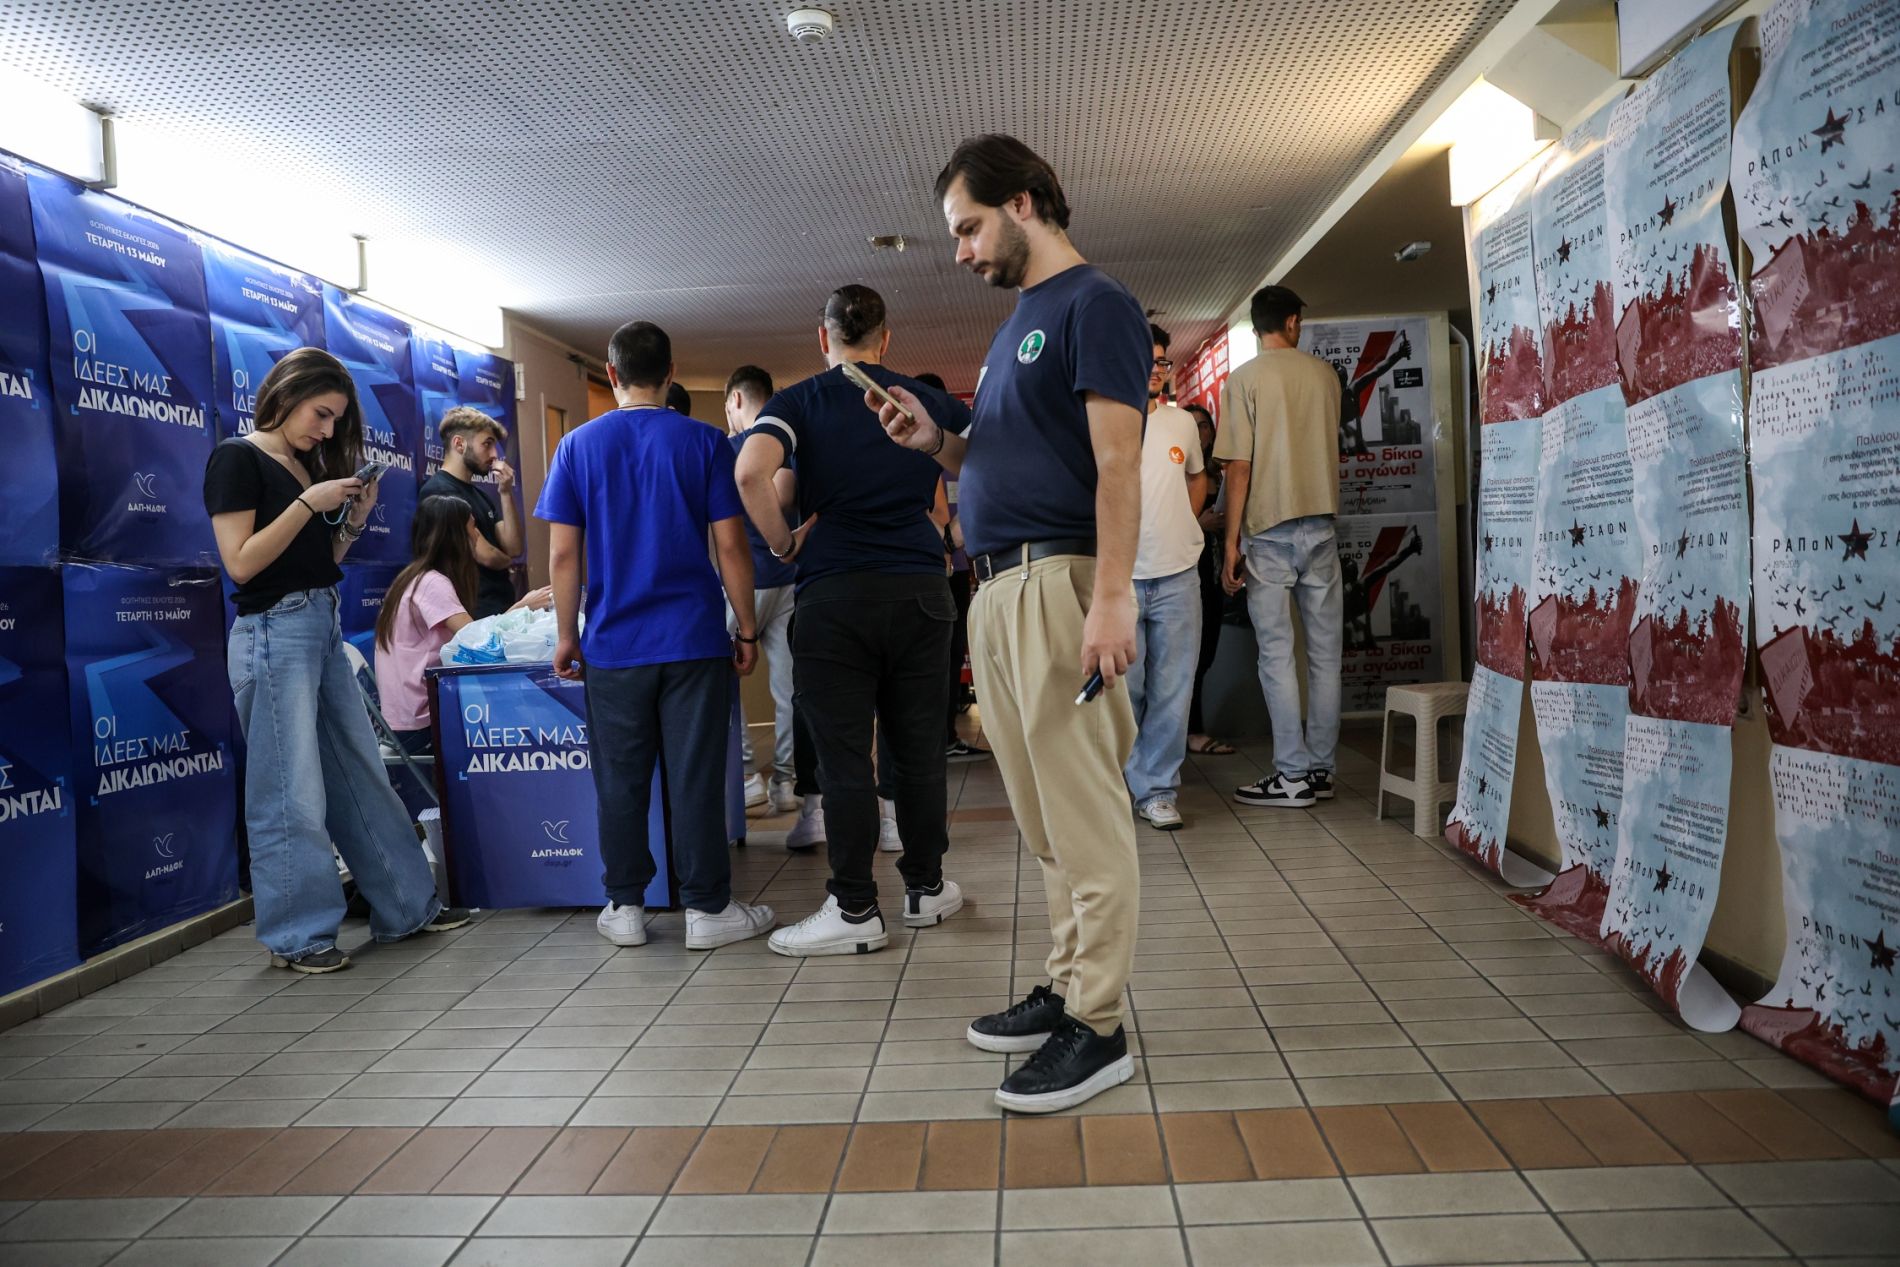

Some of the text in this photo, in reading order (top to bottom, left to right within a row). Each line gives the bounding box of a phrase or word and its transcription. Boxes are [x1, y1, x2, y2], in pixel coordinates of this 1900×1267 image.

[85, 232, 166, 268] ΤΕΤΑΡΤΗ 13 ΜΑΪΟΥ
[241, 287, 298, 314] ΤΕΤΑΡΤΗ 13 ΜΑΪΟΥ
[74, 329, 96, 353] ΟΙ
[1312, 346, 1321, 355] ή
[1326, 347, 1341, 356] με
[74, 356, 172, 397] ΙΔΕΕΣ ΜΑΣ
[233, 368, 249, 390] ΟΙ
[77, 386, 204, 428] ΔΙΚΑΙΩΝΟΝΤΑΙ
[233, 392, 256, 414] ΙΔΕ
[375, 430, 396, 448] ΜΑΣ
[425, 426, 433, 440] ΟΙ
[1357, 452, 1376, 462] το
[1382, 446, 1422, 461] δίκιο
[1600, 450, 1629, 463] απέναντ
[1355, 462, 1416, 480] αγώνα!
[127, 502, 167, 513] ΔΑΠ-ΝΔΦΚ
[1852, 501, 1858, 509] &
[1589, 521, 1627, 538] ΣΑΦΝ
[1357, 541, 1372, 549] το
[361, 598, 381, 607] ΤΕΤΑΡΤΗ
[116, 607, 191, 622] ΤΕΤΑΡΤΗ 13 ΜΑΪΟΥ
[1365, 647, 1384, 656] το
[1390, 641, 1431, 657] δίκιο
[1363, 657, 1425, 675] αγώνα!
[464, 703, 490, 724] ΟΙ
[95, 715, 116, 738] ΟΙ
[466, 724, 589, 748] ΙΔΕΕΣ ΜΑΣ
[95, 730, 190, 766] ΙΔΕΕΣ ΜΑΣ
[98, 751, 223, 796] ΔΙΚΑΙΩΝΟΝΤΑΙ
[531, 848, 583, 857] ΔΑΠ-ΝΔΦΚ
[145, 860, 184, 879] ΔΑΠ-ΝΔΦΚ
